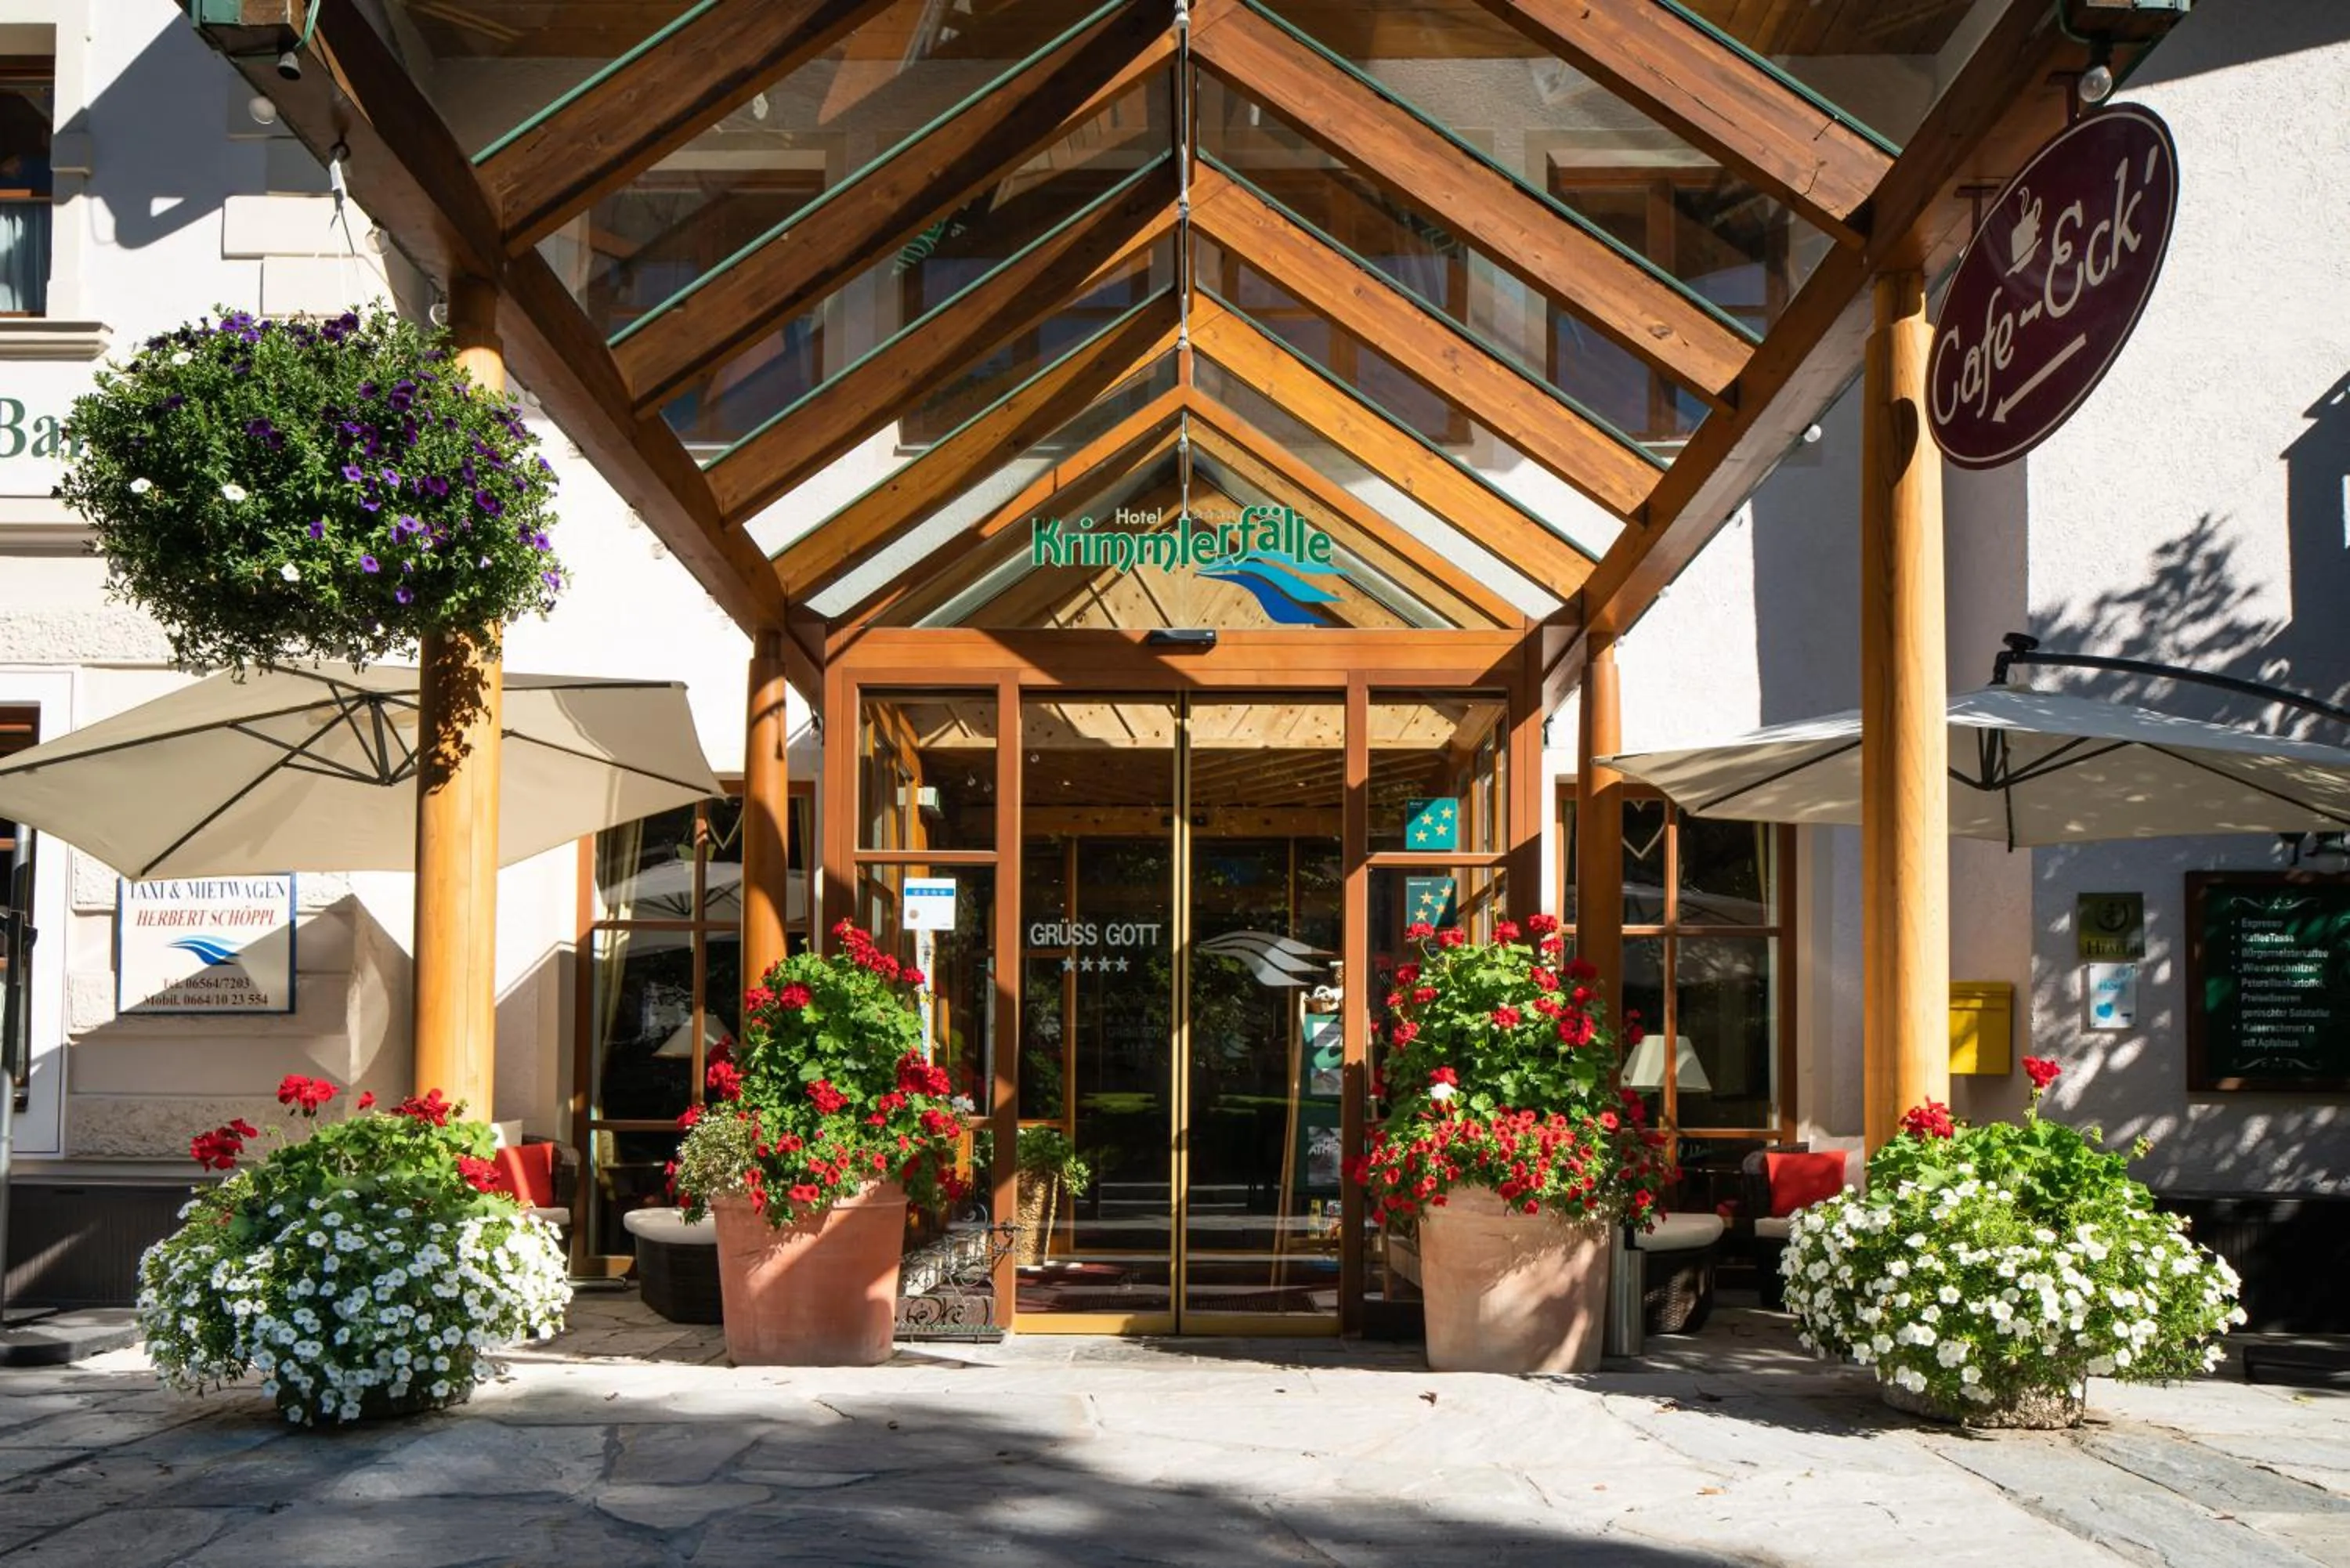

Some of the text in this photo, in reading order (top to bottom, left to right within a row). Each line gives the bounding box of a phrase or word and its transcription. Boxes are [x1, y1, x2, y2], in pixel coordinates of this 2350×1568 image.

[1115, 508, 1162, 524] Hotel
[1032, 504, 1333, 576] Krimmlerfälle
[128, 880, 285, 900] TAXI & MIETWAGEN
[136, 905, 277, 927] HERBERT SCHÖPPL
[1029, 918, 1162, 946] GRÜSS GOTT
[183, 995, 228, 1006] 0664/10
[231, 995, 245, 1006] 23
[248, 994, 269, 1006] 554
